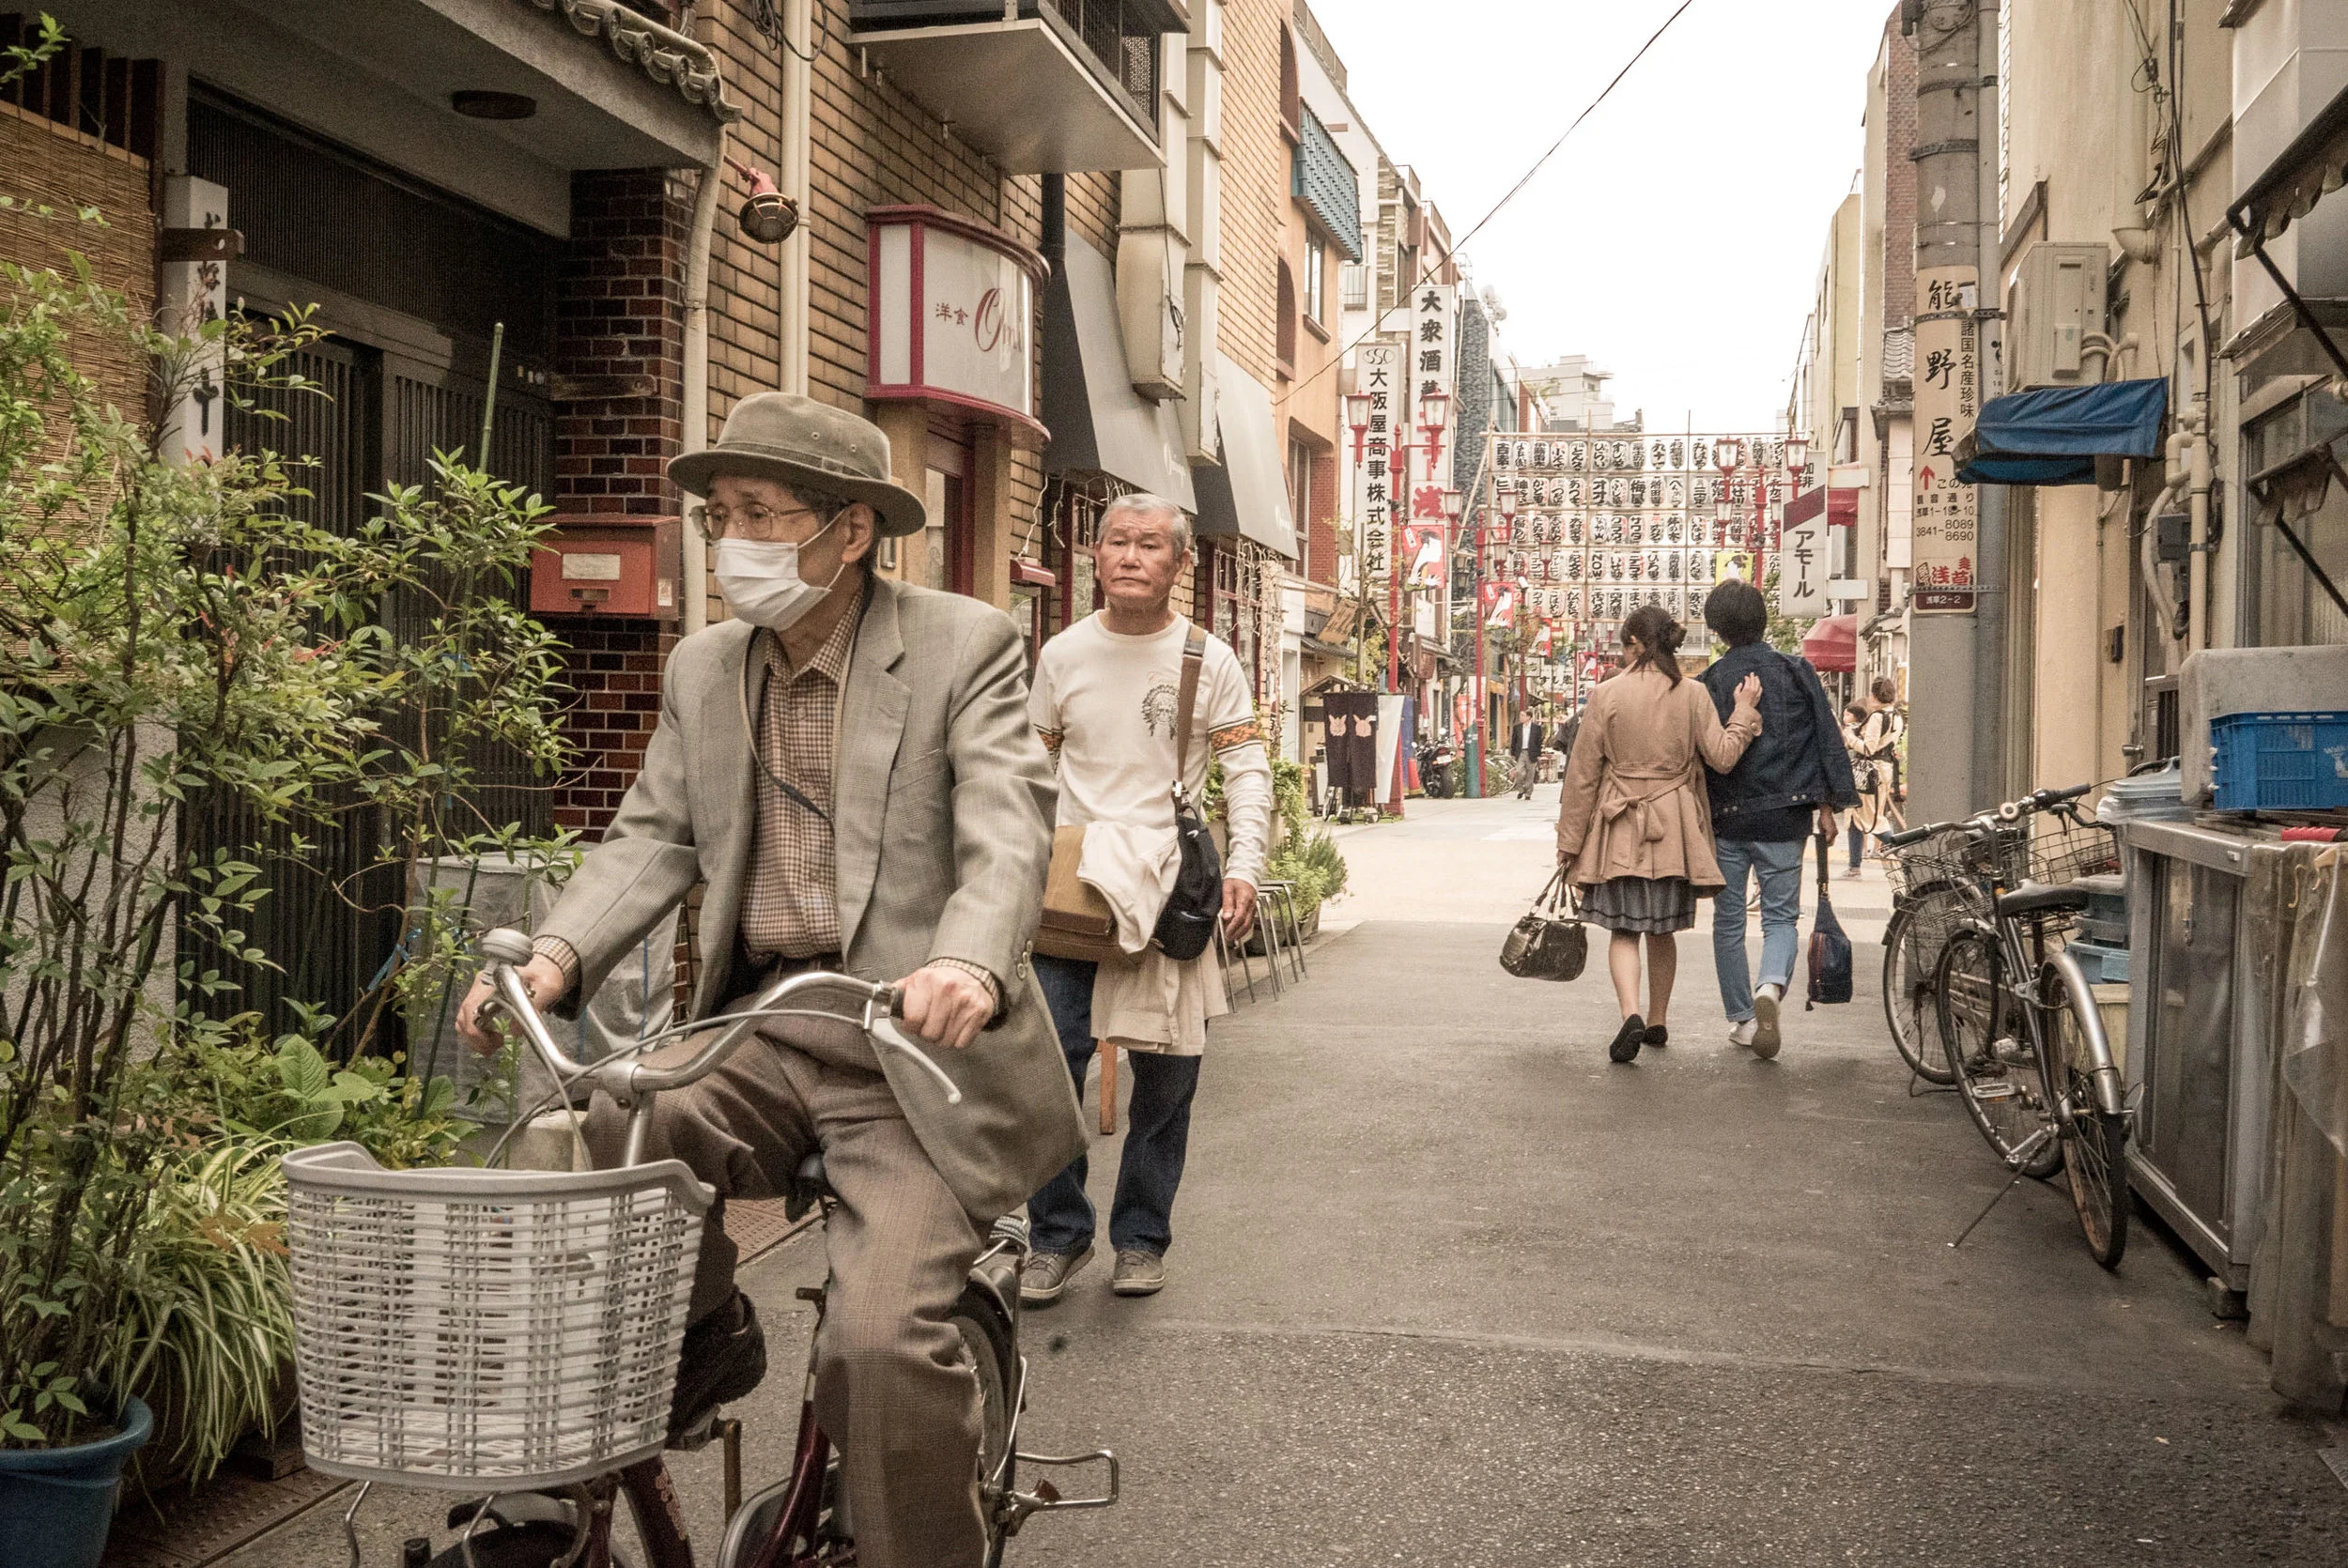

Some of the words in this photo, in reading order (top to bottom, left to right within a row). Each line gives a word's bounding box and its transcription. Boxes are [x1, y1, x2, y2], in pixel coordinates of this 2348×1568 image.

[935, 302, 968, 325] 洋食
[1960, 318, 1974, 418] 諸国名産珍味
[1367, 368, 1388, 571] 大阪屋商事株式会社
[1945, 519, 1973, 530] 8089
[1945, 530, 1973, 541] 8690
[1794, 530, 1815, 598] アモール
